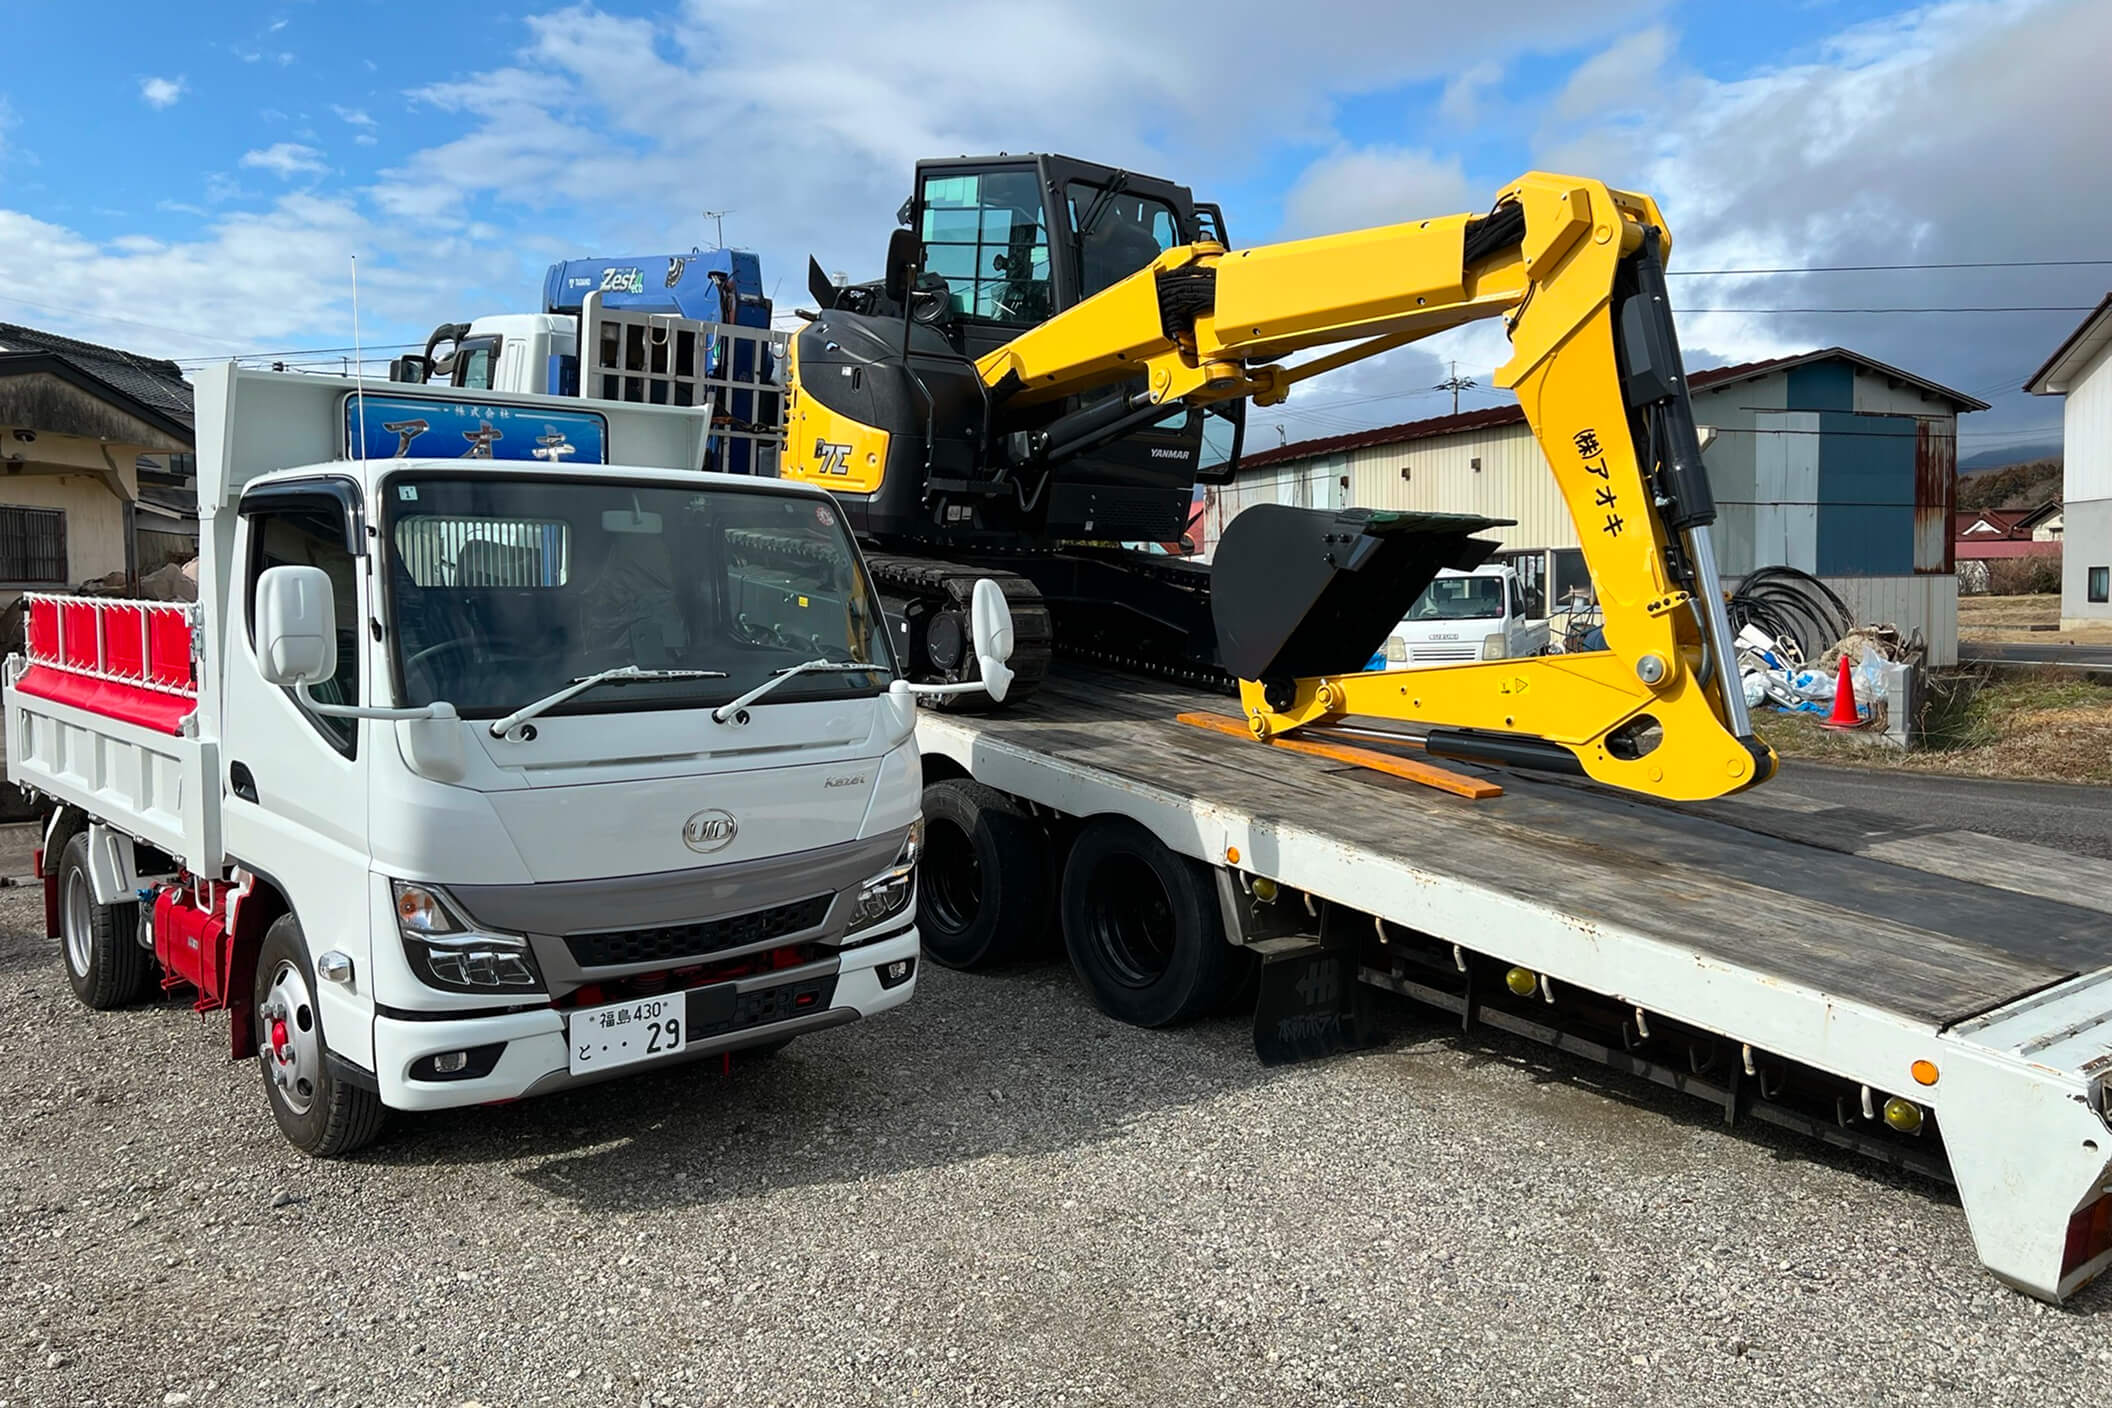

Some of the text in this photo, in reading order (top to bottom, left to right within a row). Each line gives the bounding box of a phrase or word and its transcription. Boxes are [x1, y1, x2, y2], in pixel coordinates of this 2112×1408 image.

[600, 267, 637, 290] Zest
[455, 404, 510, 419] 株式会社
[1151, 448, 1190, 460] YANMAR
[646, 1018, 680, 1054] 29
